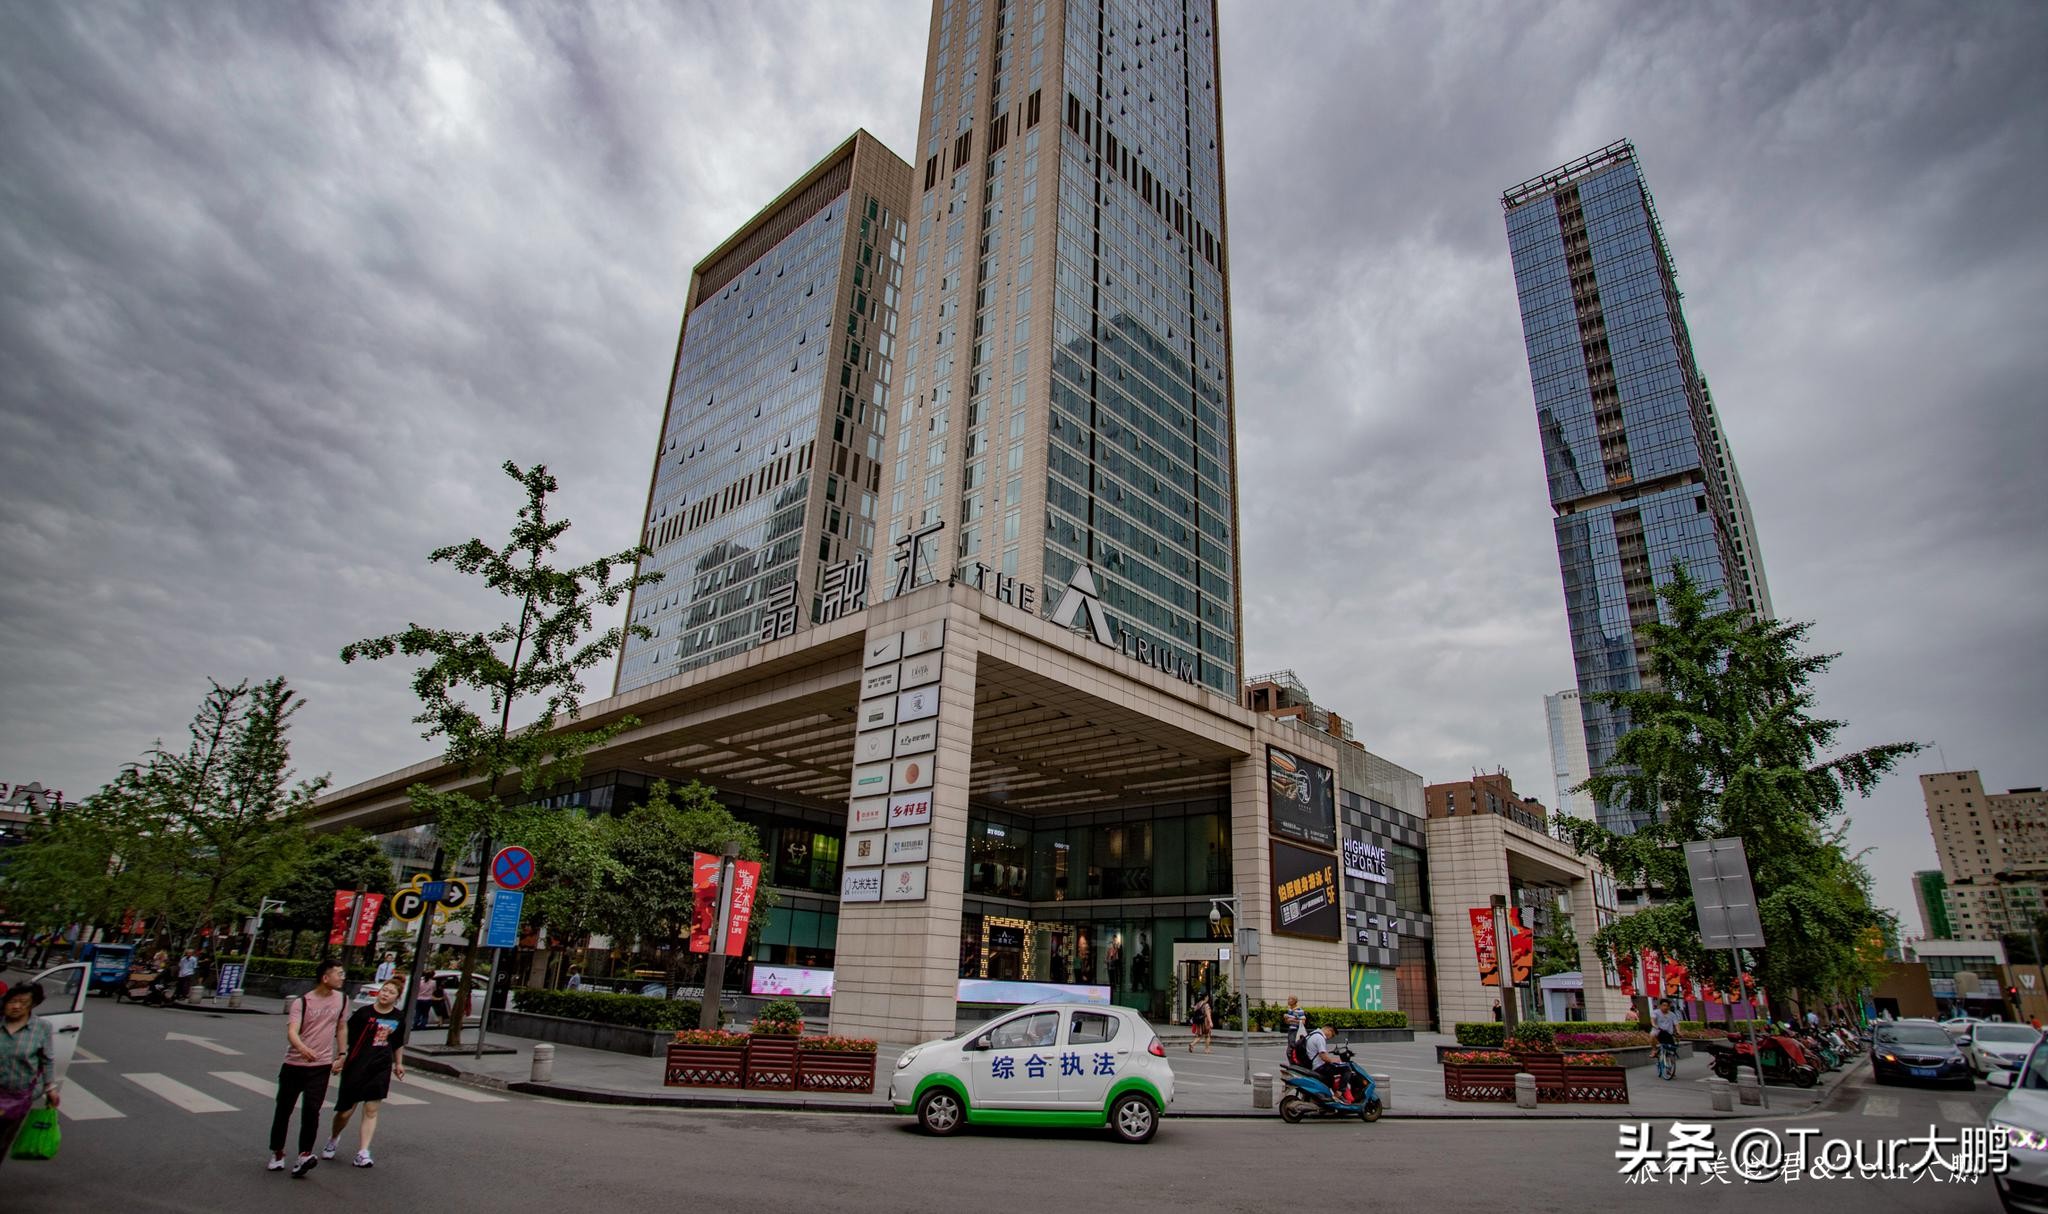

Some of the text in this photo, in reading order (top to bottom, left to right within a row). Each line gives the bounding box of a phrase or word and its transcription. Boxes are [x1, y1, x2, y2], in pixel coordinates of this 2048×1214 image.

[758, 521, 945, 646] 晶融汇
[976, 562, 1035, 614] THE
[892, 801, 928, 818] 乡村基
[1343, 837, 1386, 861] HIGHWAVE
[1344, 853, 1387, 875] SPORTS
[402, 895, 420, 915] P
[992, 1051, 1115, 1079] 综合执法
